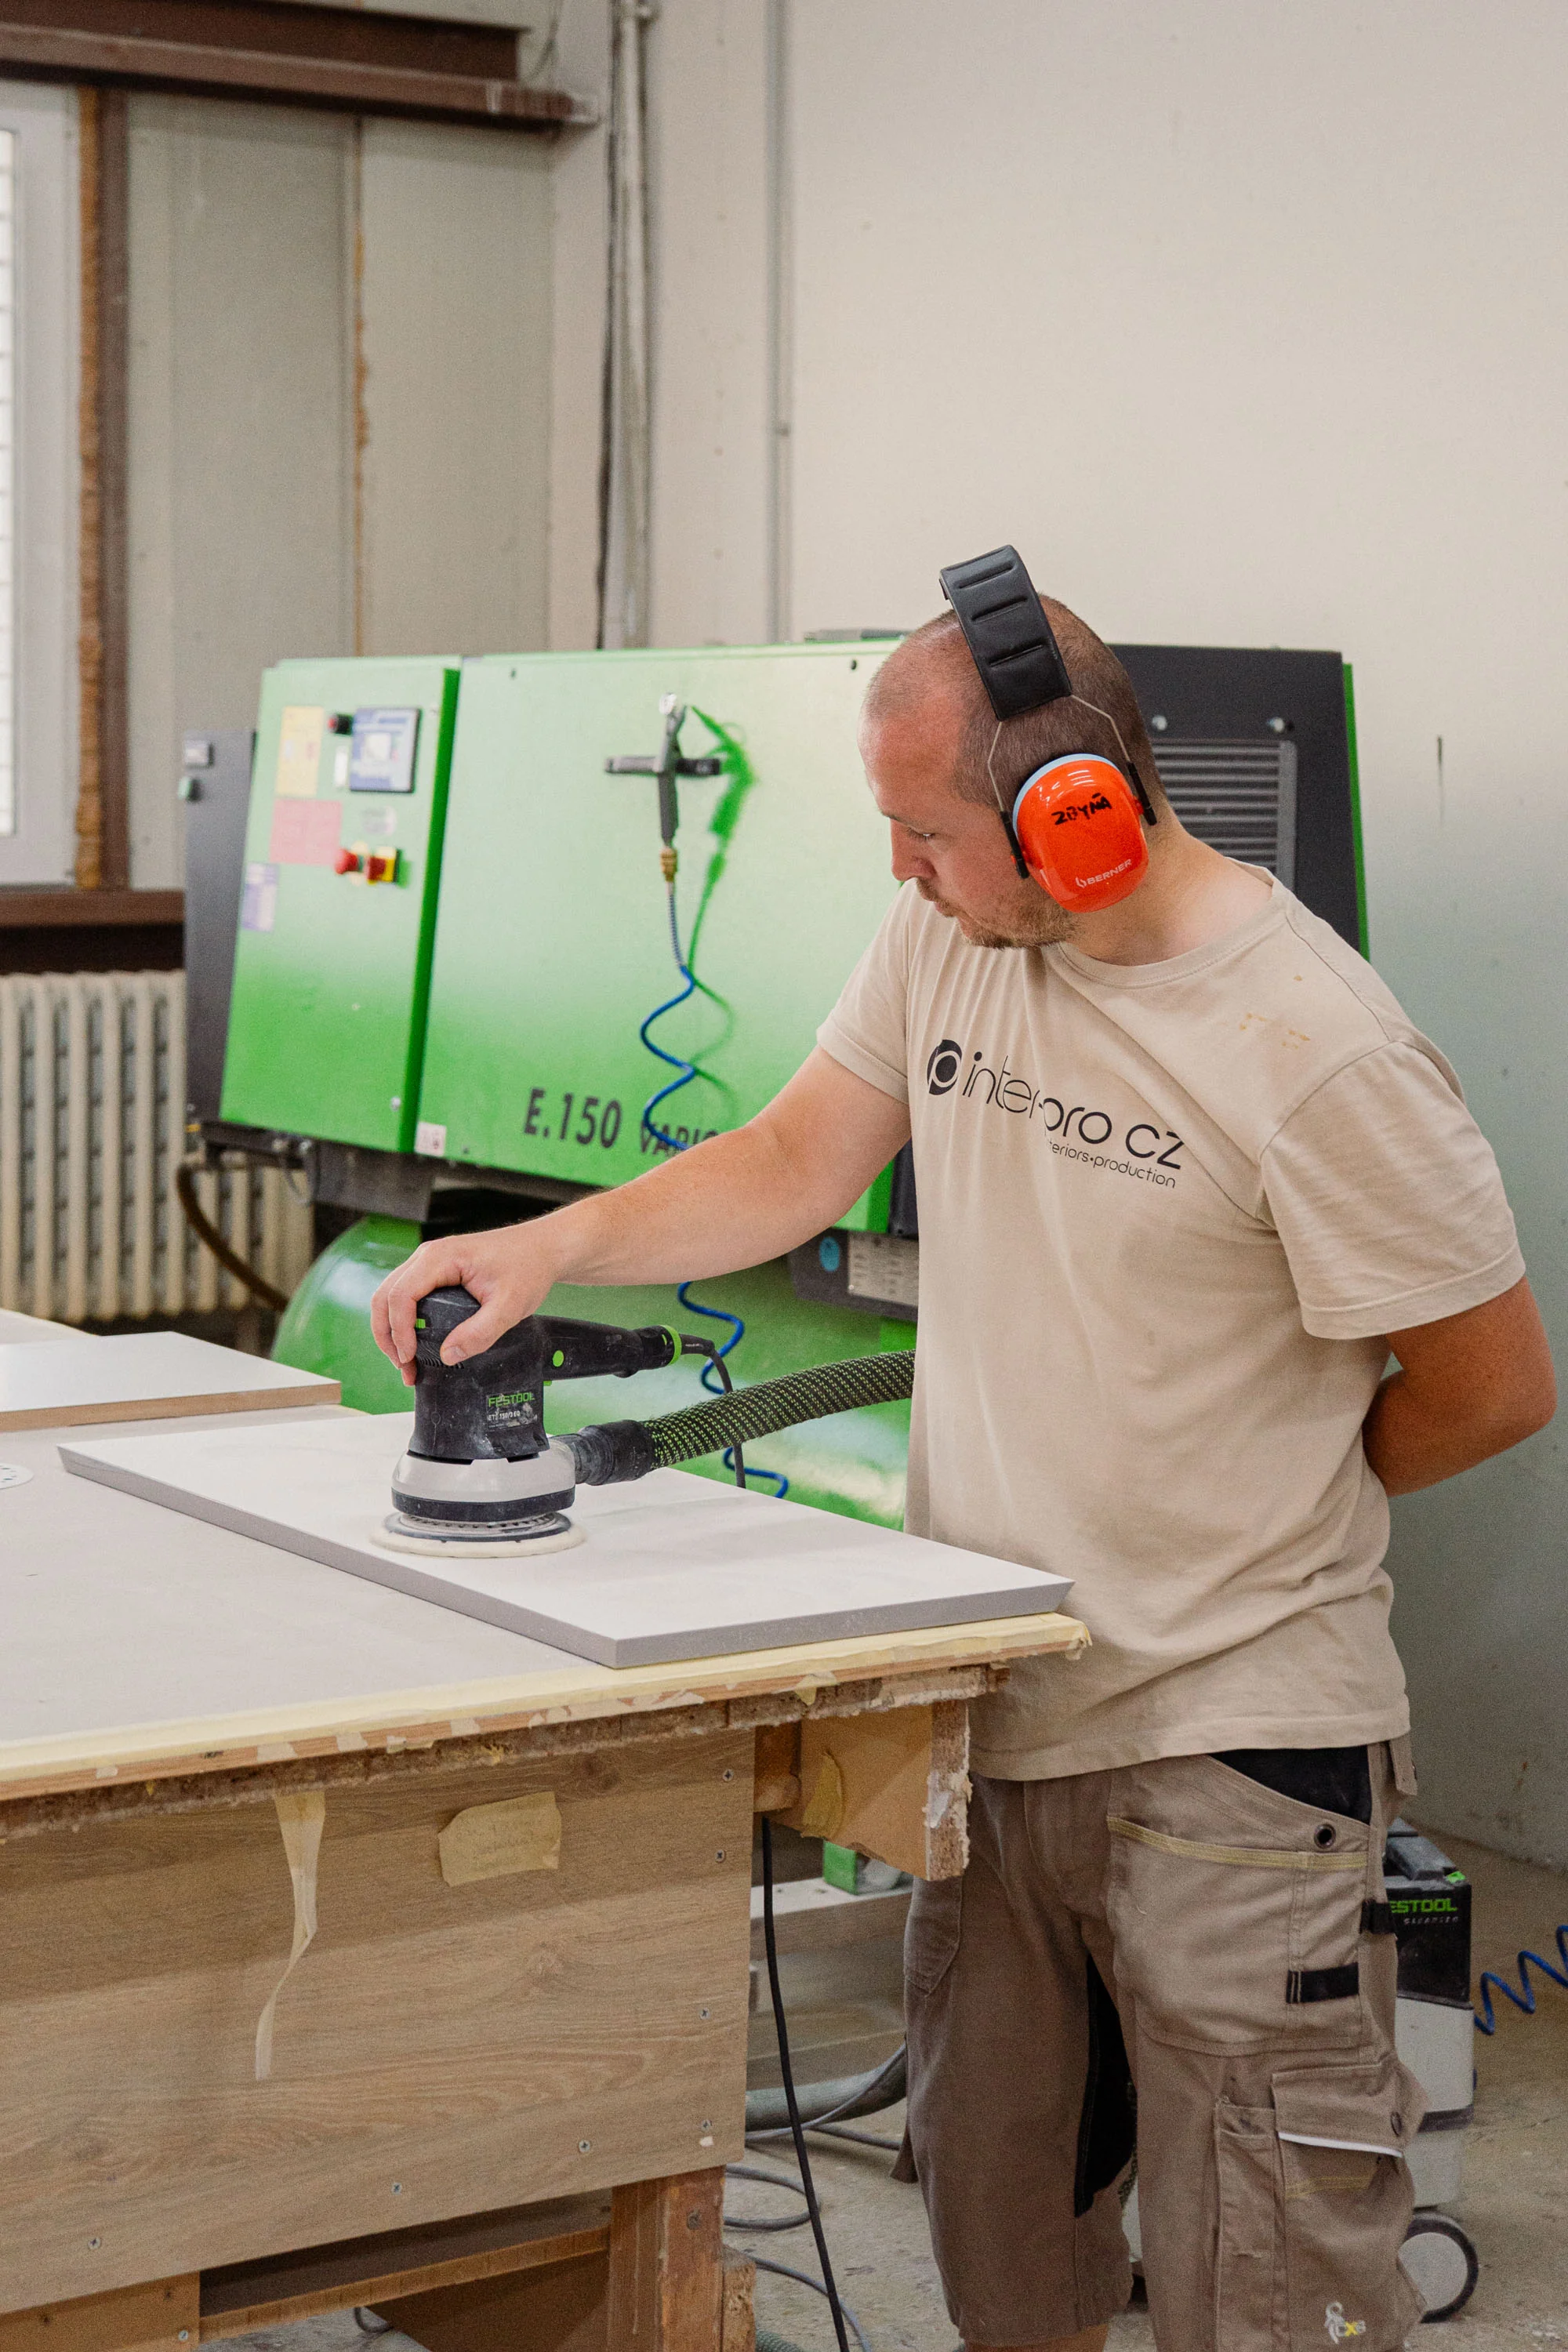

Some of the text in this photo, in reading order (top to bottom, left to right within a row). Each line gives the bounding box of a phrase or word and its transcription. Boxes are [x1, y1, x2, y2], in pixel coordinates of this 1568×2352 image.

[1087, 858, 1131, 885] BERNER
[524, 1087, 720, 1156] E.150 VARI
[488, 1392, 535, 1408] FESTOOL
[1388, 1898, 1458, 1914] ESTOOL
